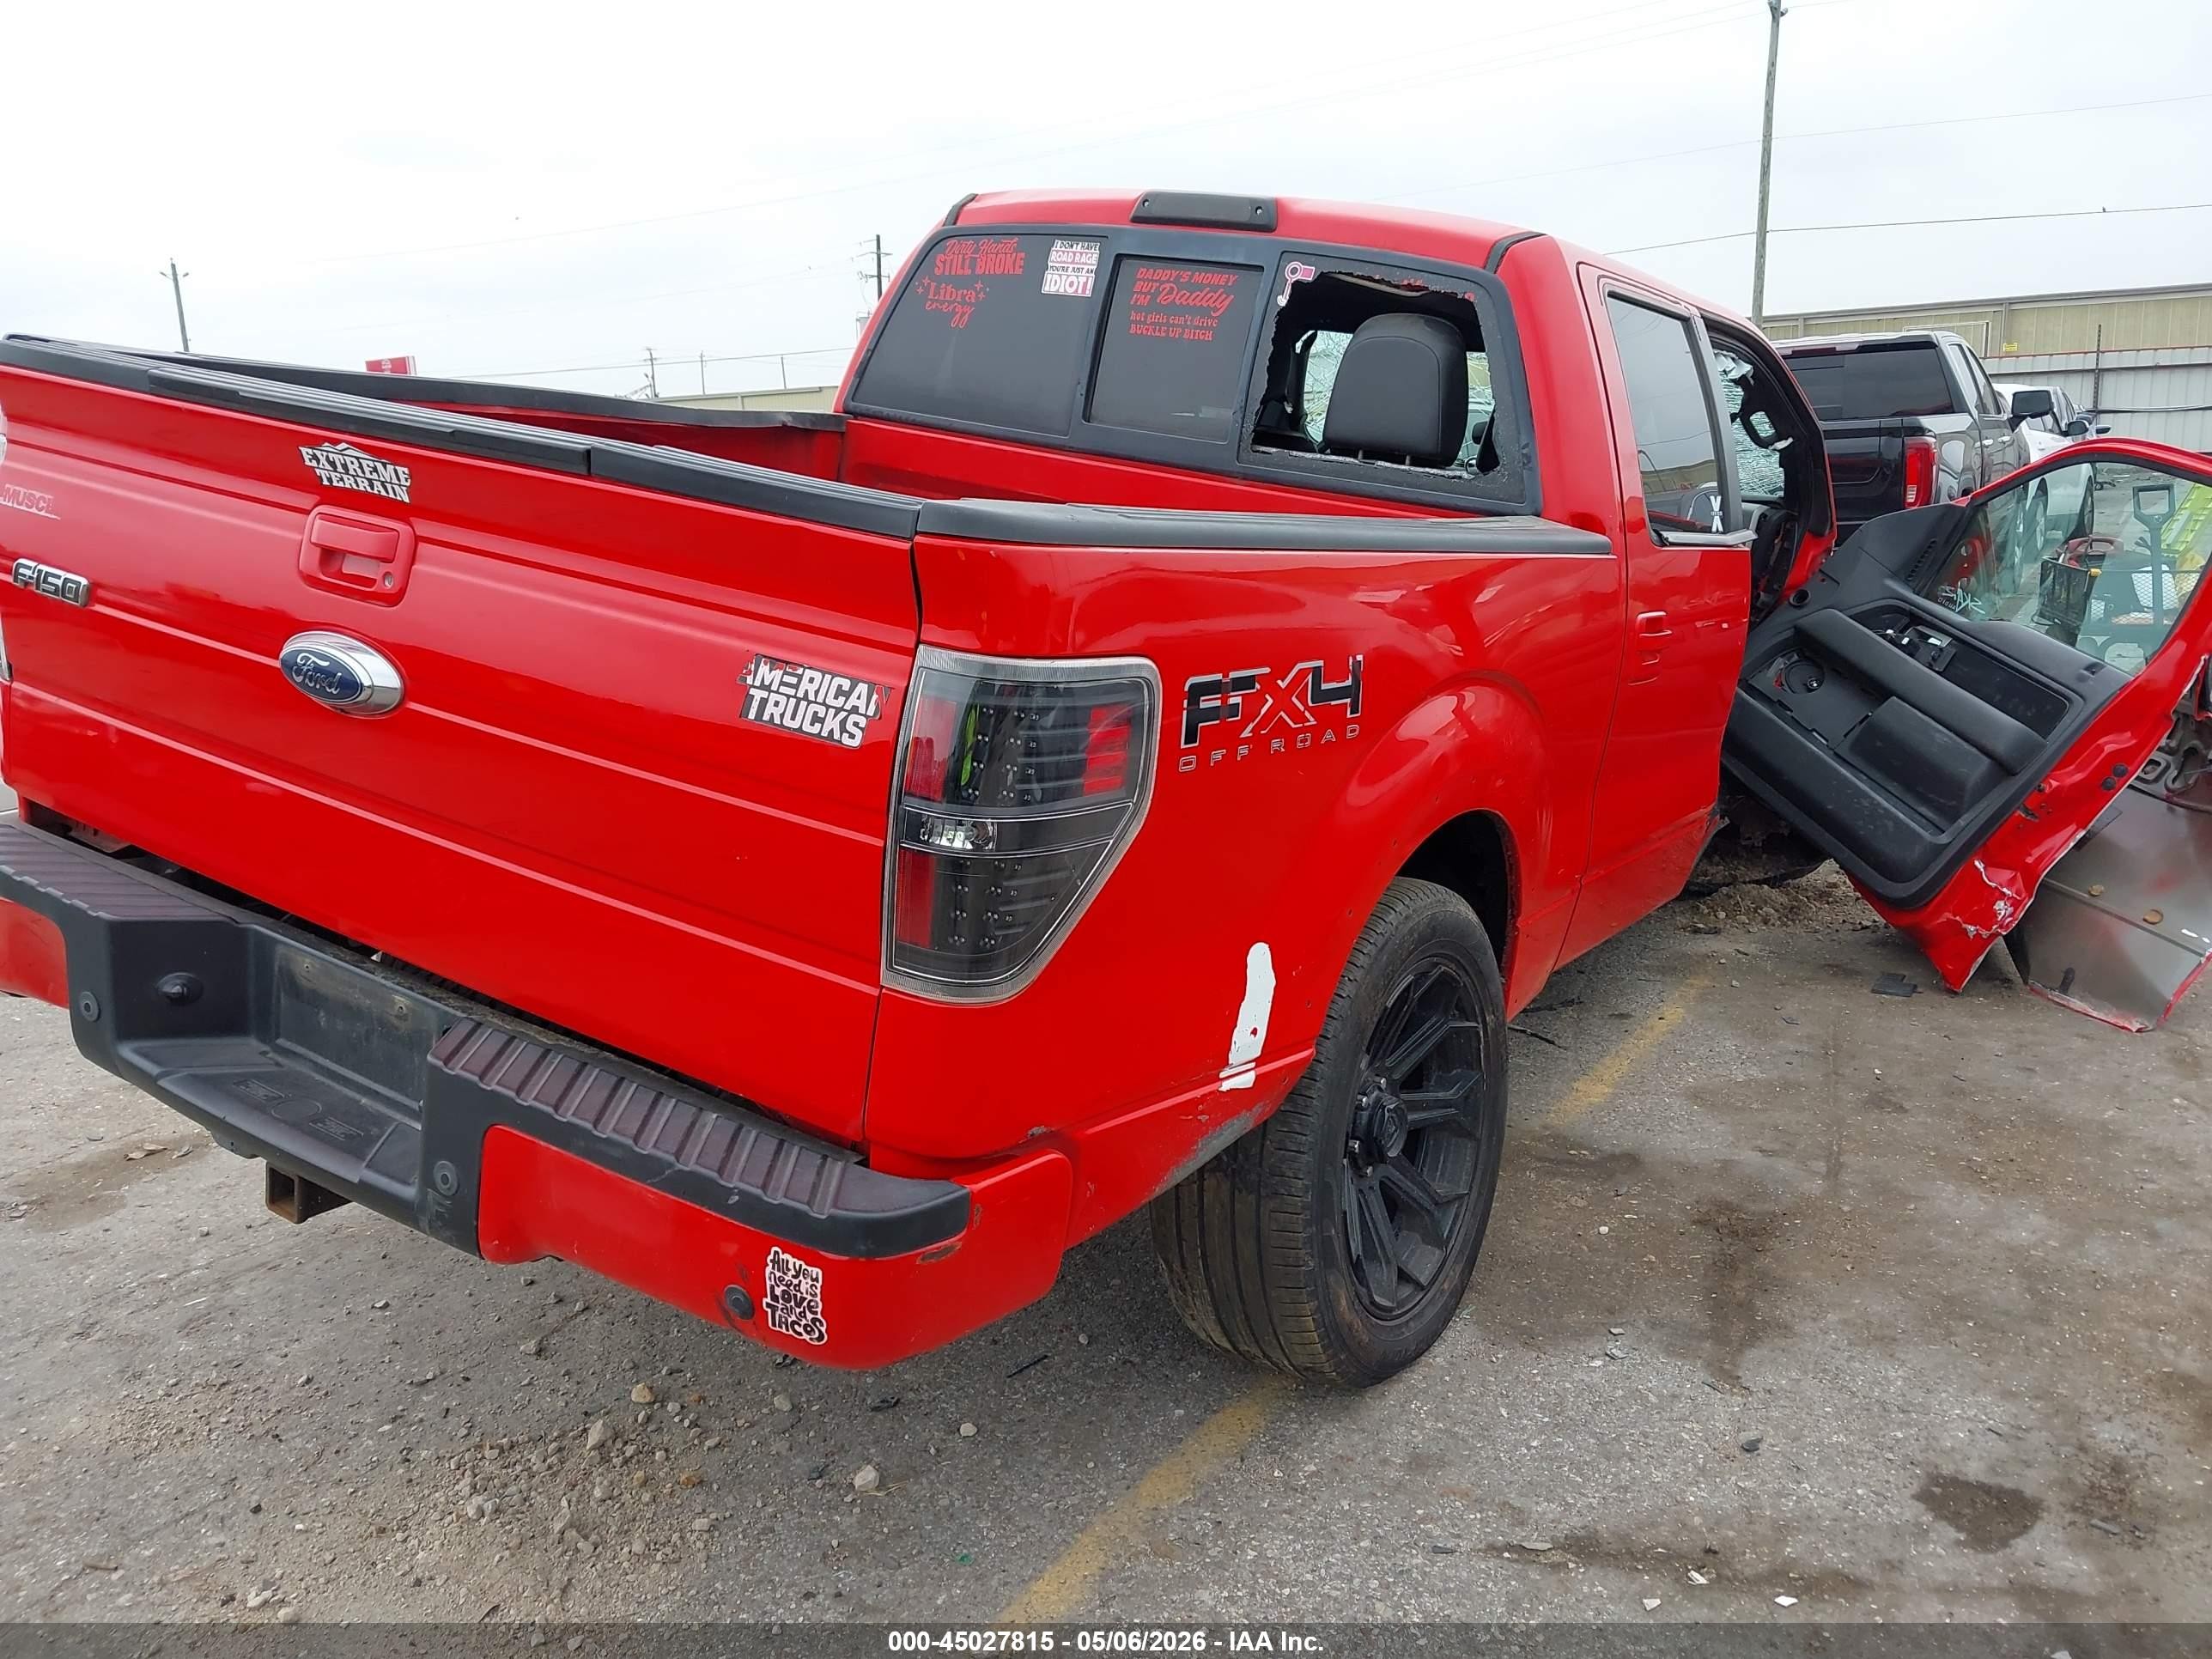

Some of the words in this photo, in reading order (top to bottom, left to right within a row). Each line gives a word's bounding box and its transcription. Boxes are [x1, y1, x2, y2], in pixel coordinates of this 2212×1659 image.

[945, 239, 977, 257] Dirty
[1050, 250, 1075, 263] ROAD
[1075, 252, 1099, 264] RAGE
[1060, 241, 1080, 250] DON'T
[1081, 242, 1100, 252] HAVE
[934, 252, 972, 276] STILL
[975, 252, 1025, 276] BROKE
[1043, 274, 1093, 295] IDIOT!
[1133, 281, 1160, 293] BUT
[1136, 267, 1192, 283] DADDY'S
[1192, 271, 1239, 286] MONEY
[927, 282, 976, 303] Libra
[1129, 294, 1152, 306] I'M
[1157, 282, 1235, 317] Daddy
[1130, 310, 1146, 321] hot
[1146, 312, 1168, 325] girls
[1169, 314, 1192, 325] can't
[1193, 316, 1218, 327] drive
[1129, 324, 1168, 337] BUCKLE
[1169, 326, 1182, 338] UP
[1183, 329, 1214, 341] BITCH
[300, 447, 411, 487] EXTREME
[314, 468, 410, 503] TERRAIN
[12, 560, 86, 605] F-150
[291, 652, 343, 696] Ford
[745, 687, 867, 748] TRUCKS
[1270, 725, 1360, 755] ROAD
[791, 1261, 820, 1284] you
[768, 1271, 804, 1295] need
[805, 1281, 818, 1299] is
[780, 1304, 810, 1323] and
